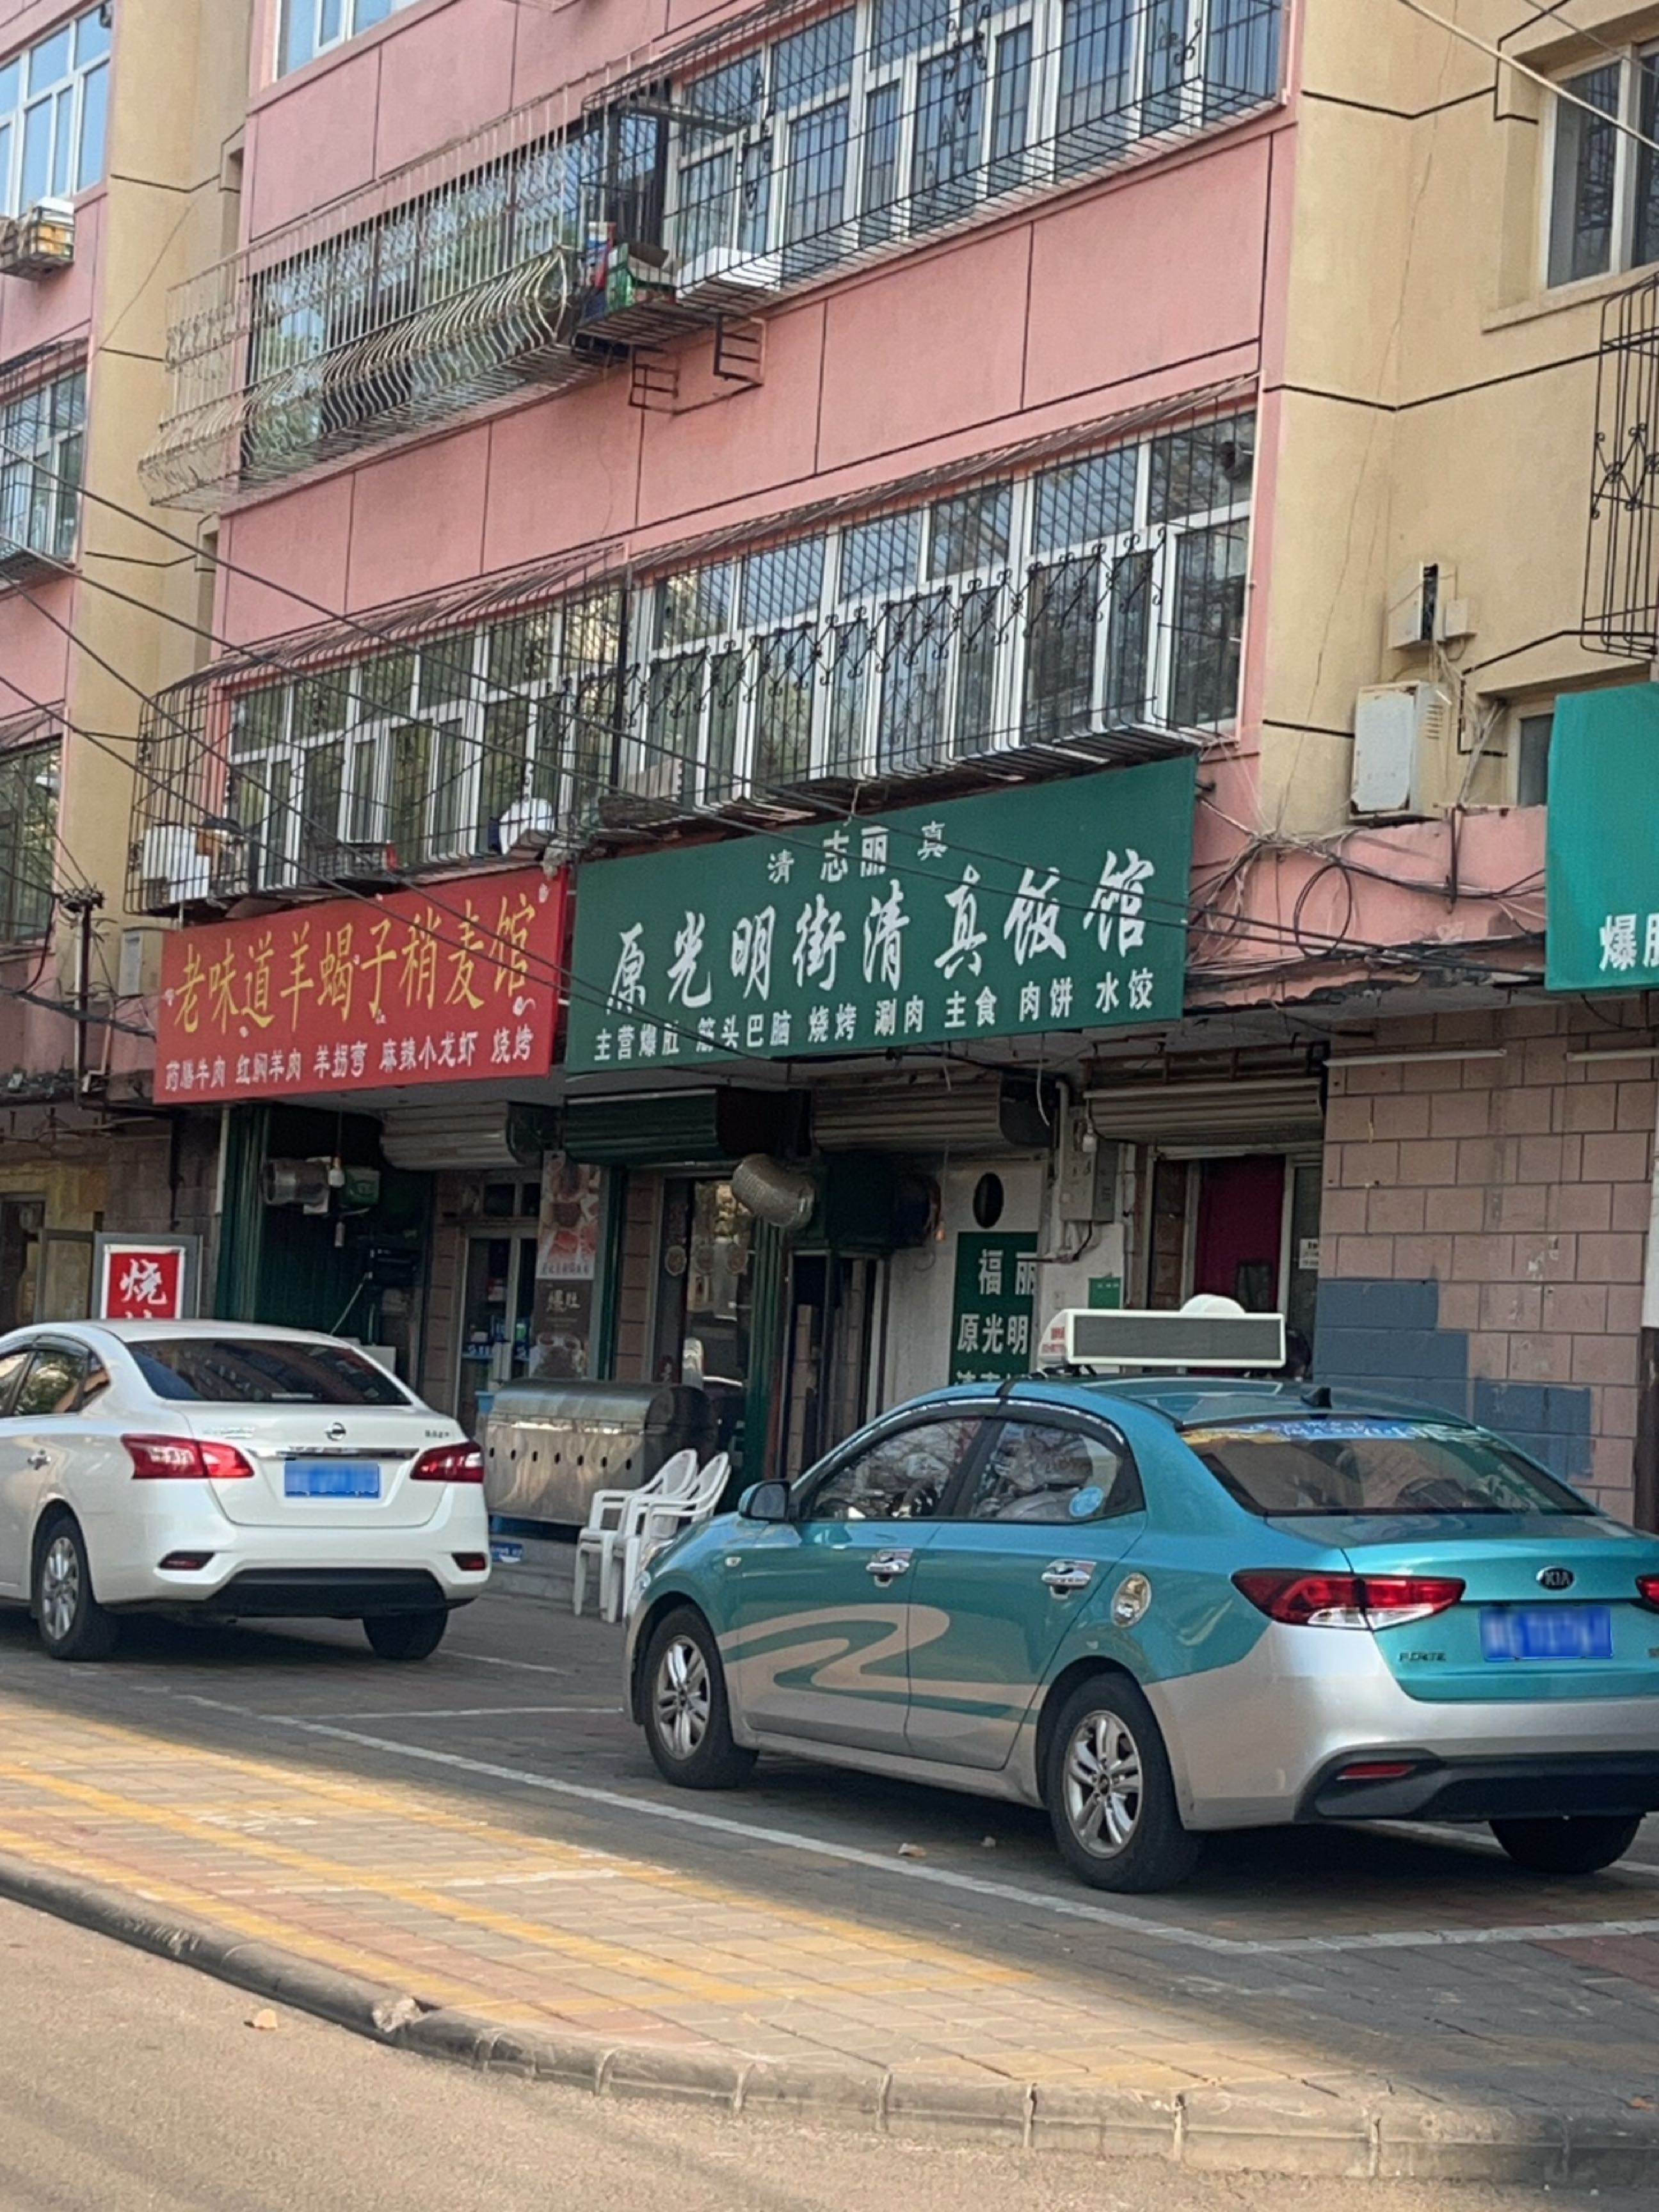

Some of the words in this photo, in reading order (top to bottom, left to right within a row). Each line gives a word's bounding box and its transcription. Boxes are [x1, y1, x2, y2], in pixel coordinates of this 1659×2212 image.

[767, 849, 794, 884] 清
[820, 826, 889, 883] 志丽
[917, 821, 948, 860] 真
[606, 849, 1155, 1015] 原光明街清真饭馆
[173, 894, 536, 1035] 老味道羊蝎子稍麦馆
[808, 1003, 858, 1043] 烧烤
[874, 995, 925, 1037] 涮肉
[944, 986, 997, 1029] 主食
[1019, 977, 1074, 1022] 肉饼
[1096, 968, 1154, 1013] 水饺
[379, 1030, 479, 1073] 麻辣小龙虾
[491, 1023, 534, 1064] 烧烤
[120, 1259, 168, 1318] 烧
[957, 1313, 1029, 1355] 原光明
[1544, 1570, 1572, 1586] KIA
